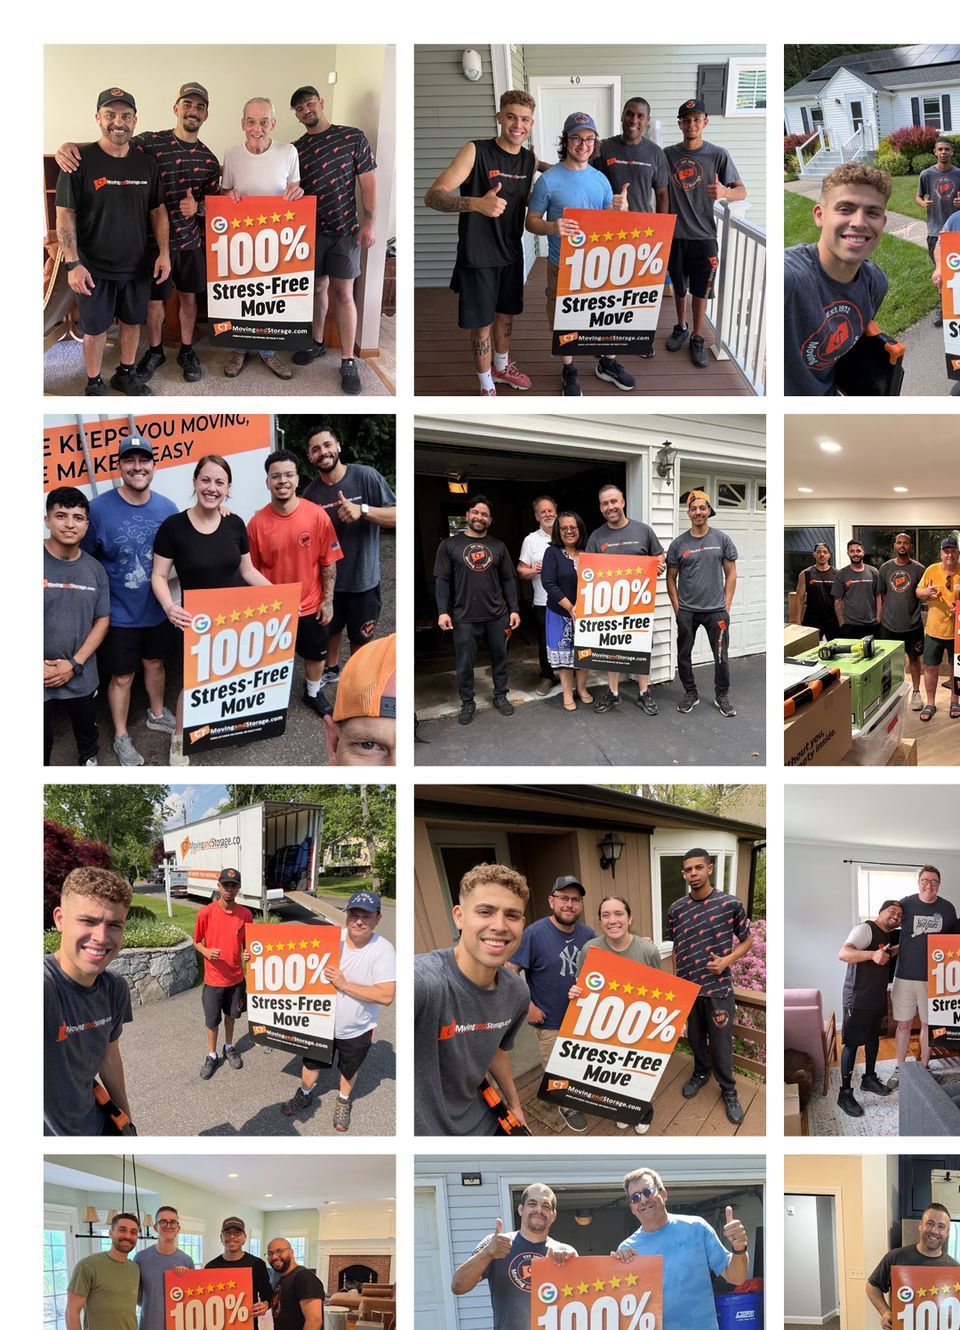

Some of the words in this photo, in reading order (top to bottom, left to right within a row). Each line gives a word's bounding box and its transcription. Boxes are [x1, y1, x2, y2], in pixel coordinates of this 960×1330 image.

[570, 76, 581, 84] 40
[211, 225, 310, 277] 100%
[565, 241, 663, 291] 100%
[212, 275, 309, 301] Stress-Free
[562, 289, 658, 313] Stress-Free
[241, 298, 285, 317] Move
[232, 325, 308, 335] MovingandStorage.com
[60, 426, 130, 452] KEEPS
[138, 421, 175, 439] YOU
[180, 414, 250, 434] MOVING,
[581, 578, 651, 615] 100%
[579, 616, 650, 634] Stress-Free
[191, 613, 291, 682] 100%
[191, 665, 289, 708] Stress-Free
[221, 691, 265, 717] Move
[250, 953, 331, 992] 100%
[252, 995, 331, 1012] Stress-Free
[573, 992, 681, 1044] 100%
[559, 1040, 662, 1072] Stress-Free
[583, 1065, 631, 1087] Move
